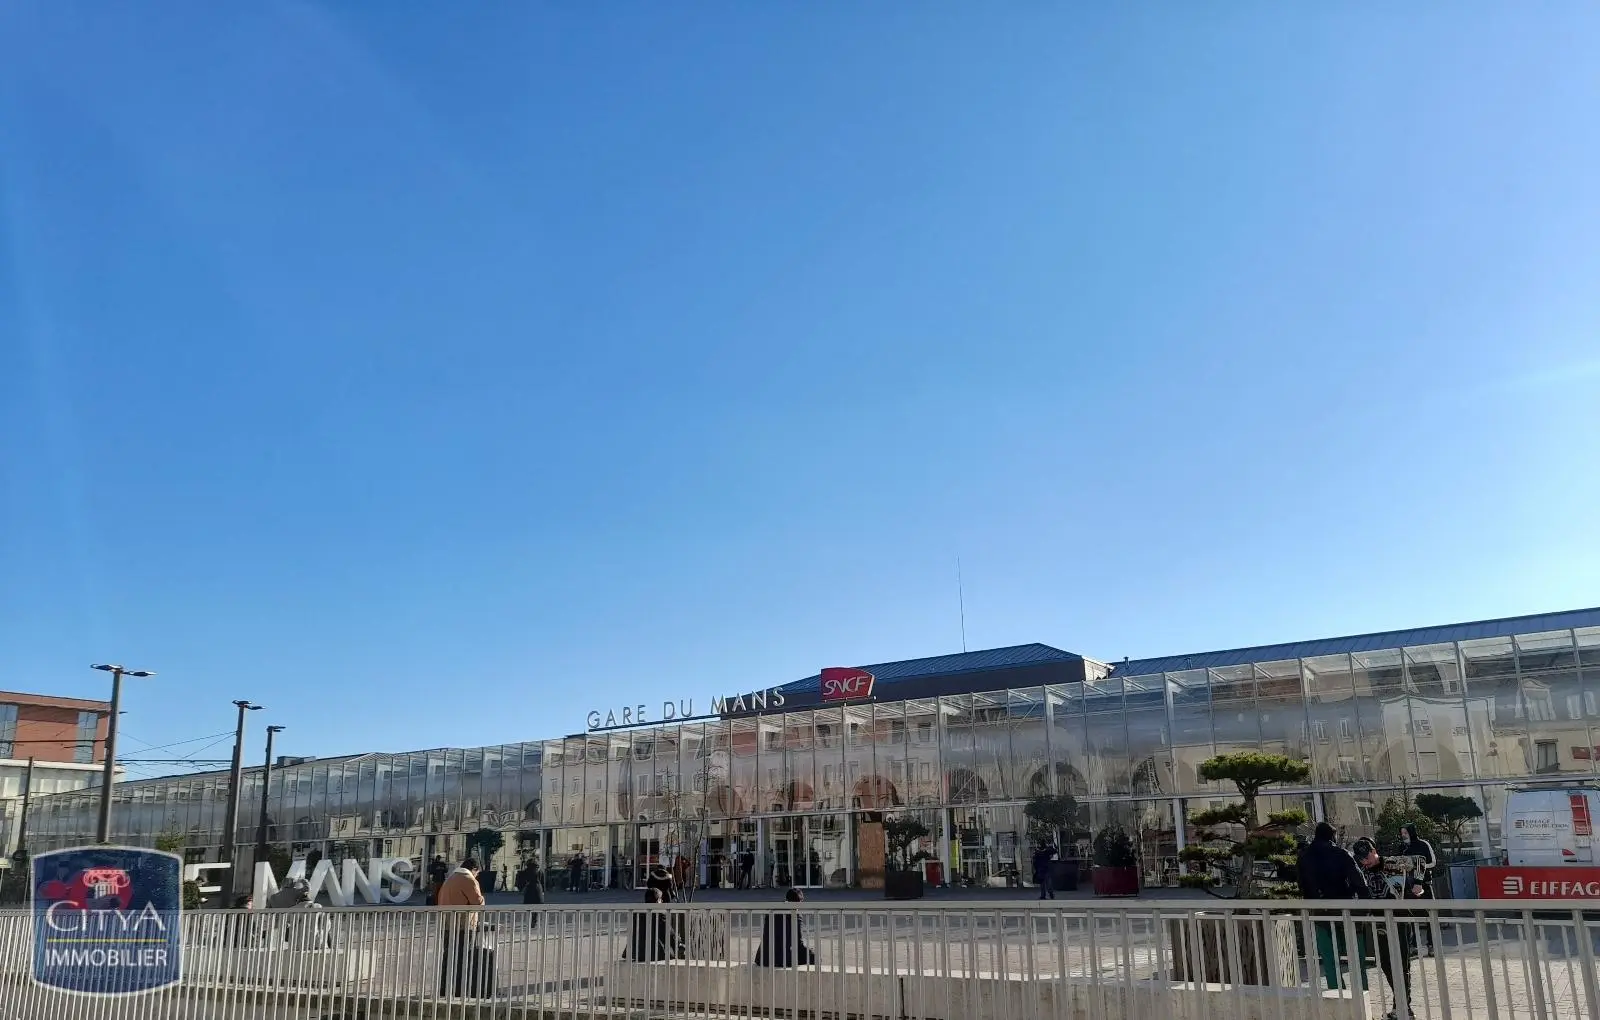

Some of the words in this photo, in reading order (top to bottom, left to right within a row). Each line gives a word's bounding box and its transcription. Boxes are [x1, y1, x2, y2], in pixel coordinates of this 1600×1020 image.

[823, 675, 869, 695] SNCF
[586, 704, 646, 728] GARE
[663, 698, 693, 719] DU
[709, 686, 785, 714] MANS
[253, 857, 414, 909] MANS
[1530, 881, 1600, 896] EIFFAG
